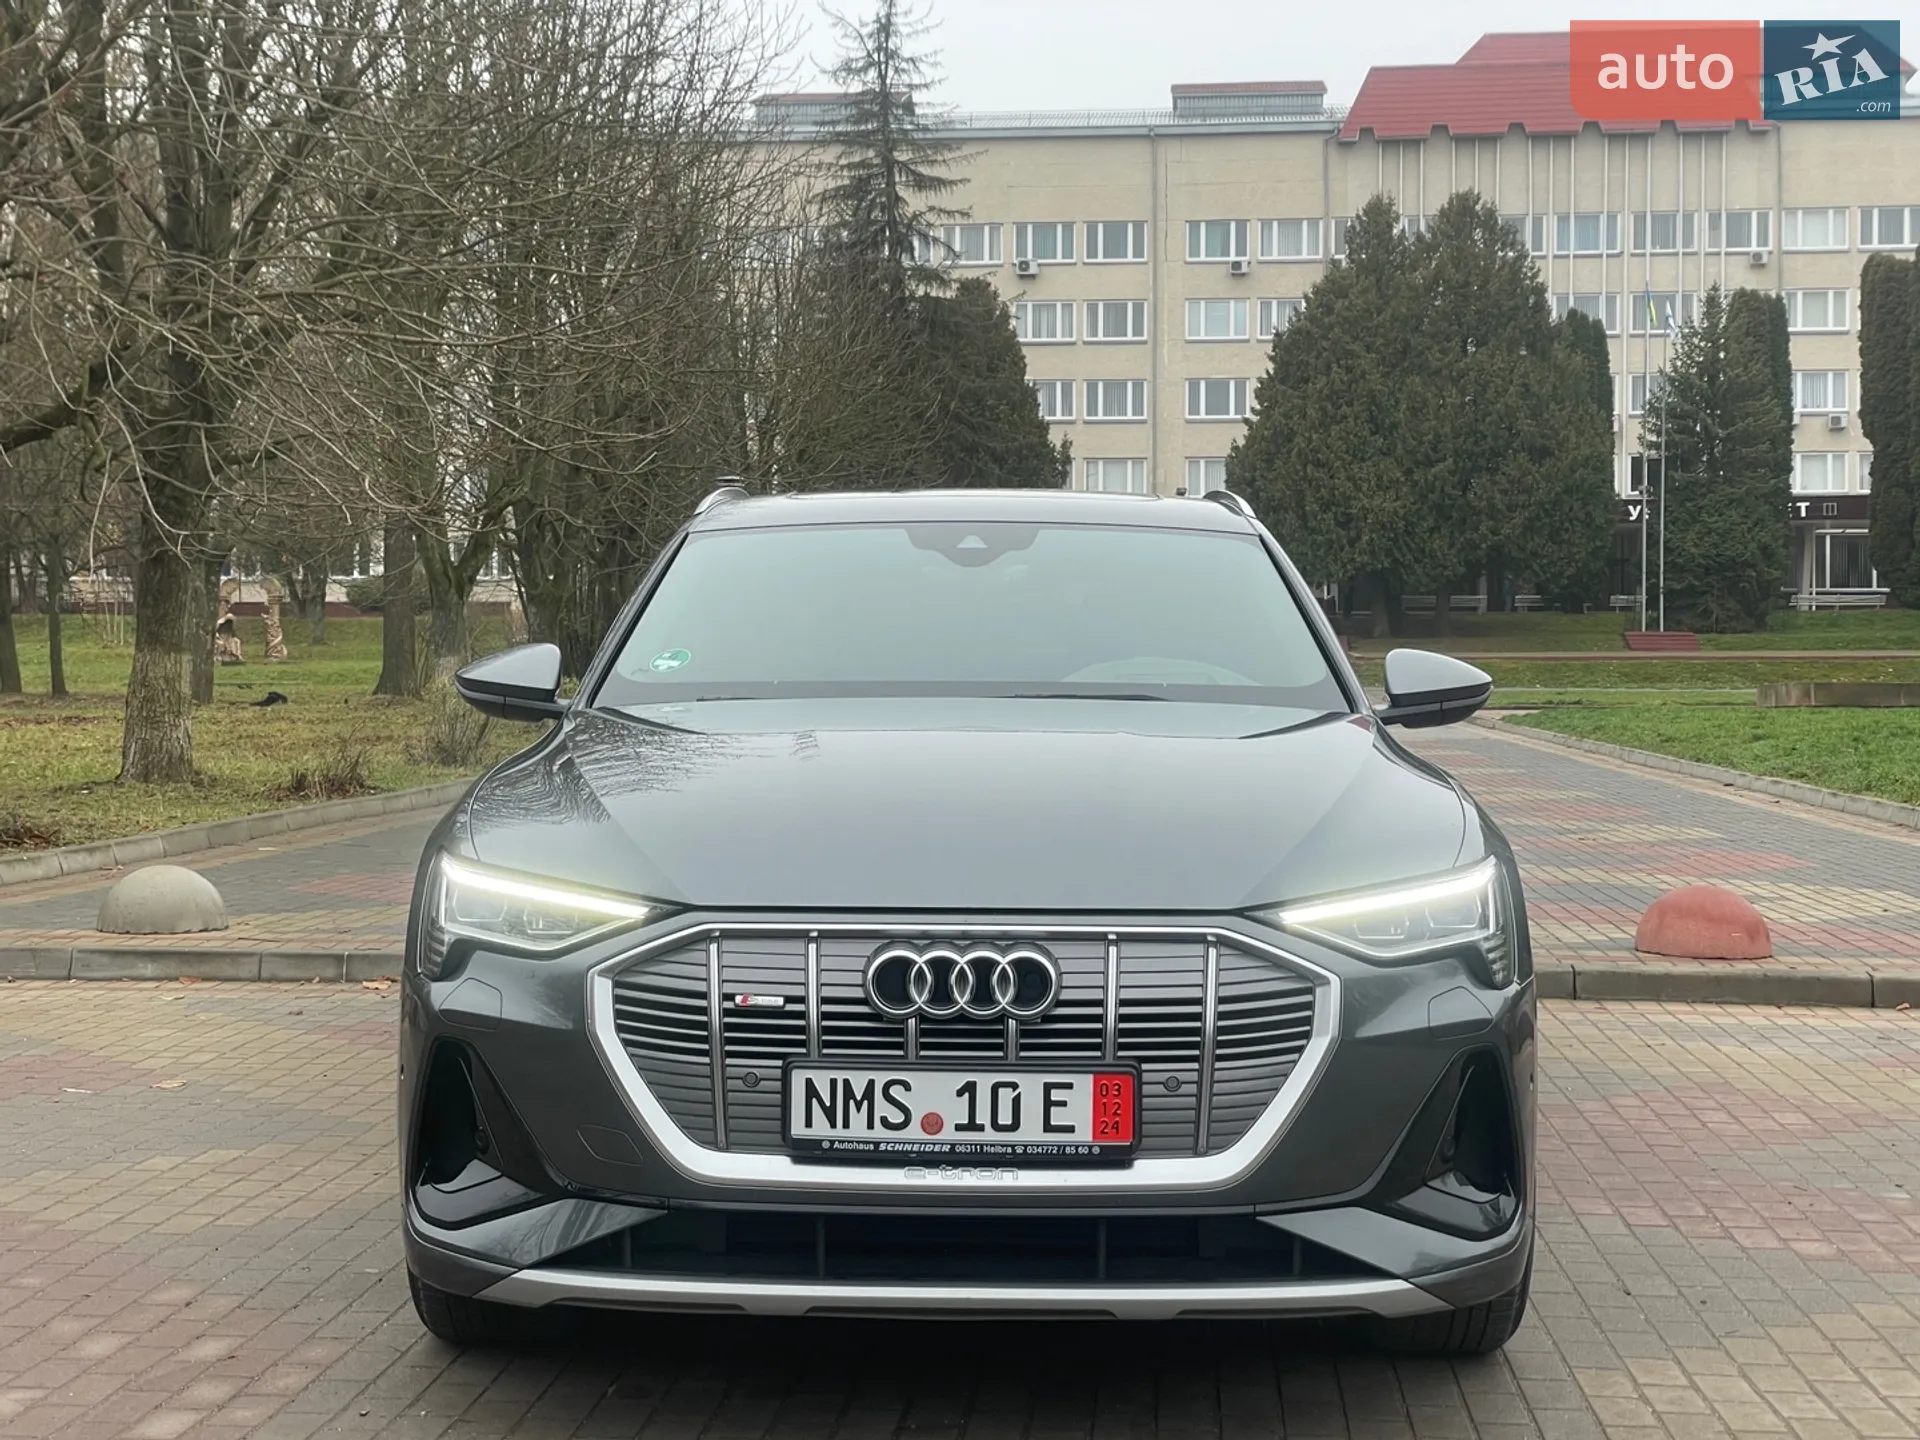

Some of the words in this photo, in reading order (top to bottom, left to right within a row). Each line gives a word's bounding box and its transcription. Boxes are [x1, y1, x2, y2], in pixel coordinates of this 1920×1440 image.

[1100, 1081, 1122, 1097] 03
[804, 1077, 912, 1131] NMS
[954, 1080, 1022, 1133] 10
[1043, 1081, 1076, 1133] E
[1101, 1100, 1122, 1116] 12
[1099, 1118, 1120, 1135] 24
[833, 1141, 875, 1151] Autohaus
[878, 1142, 952, 1153] SCHNEIDER
[1026, 1145, 1058, 1154] 034772
[1065, 1145, 1076, 1155] 85
[904, 1164, 1018, 1181] e-tron
